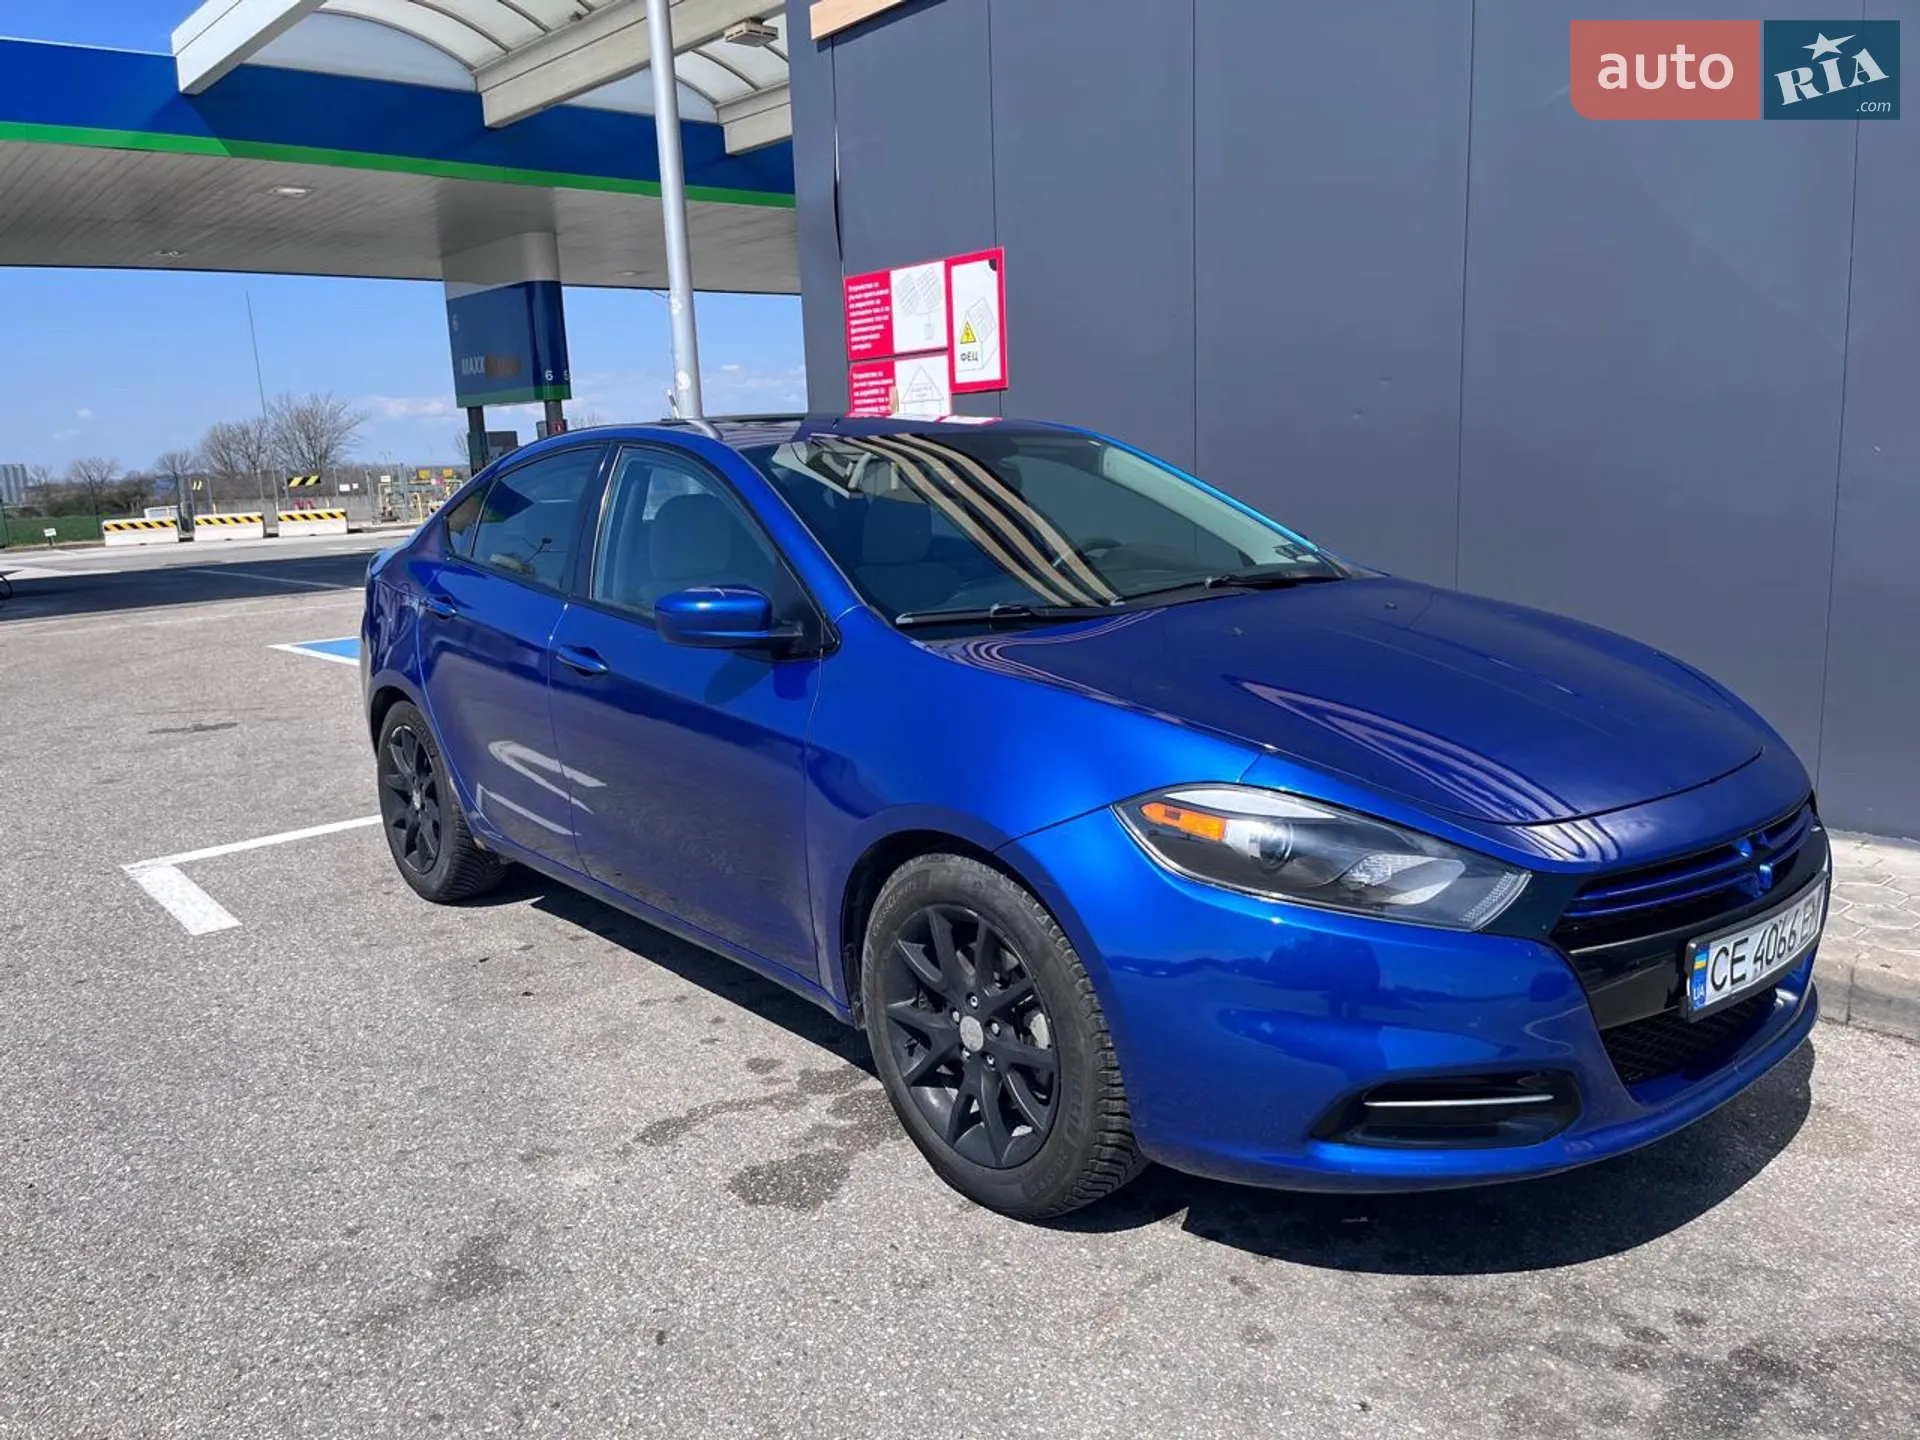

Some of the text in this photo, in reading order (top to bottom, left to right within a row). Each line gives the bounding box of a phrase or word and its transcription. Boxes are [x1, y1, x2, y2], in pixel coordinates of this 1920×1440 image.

[544, 369, 554, 381] 6
[1711, 937, 1749, 991] CE
[1752, 910, 1799, 972] 4066
